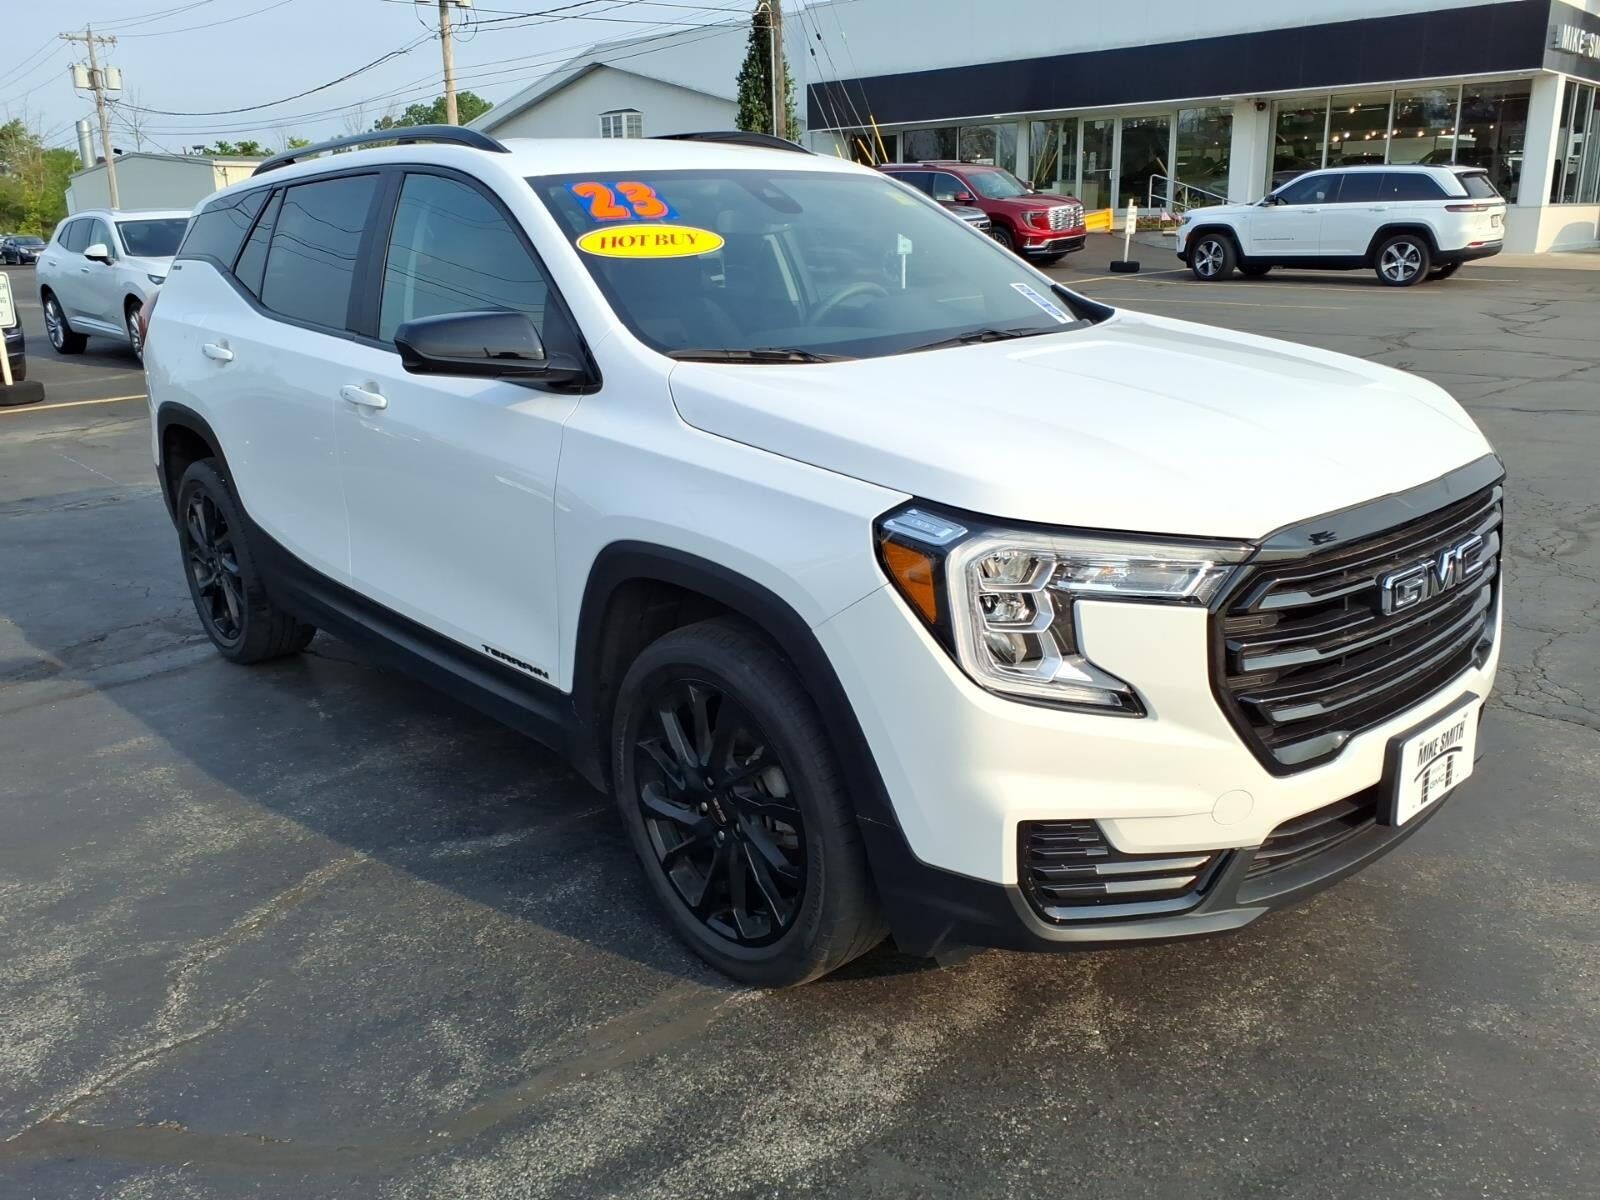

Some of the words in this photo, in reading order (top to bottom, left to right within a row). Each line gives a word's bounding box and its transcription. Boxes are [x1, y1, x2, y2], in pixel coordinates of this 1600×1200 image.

[1561, 24, 1586, 54] MIKE
[572, 181, 668, 219] 23
[600, 234, 650, 249] HOT
[655, 233, 698, 246] BUY
[1381, 535, 1483, 616] GMC
[481, 644, 549, 680] TERRAIN
[1417, 737, 1440, 767] MIKE
[1440, 719, 1466, 752] SMITH
